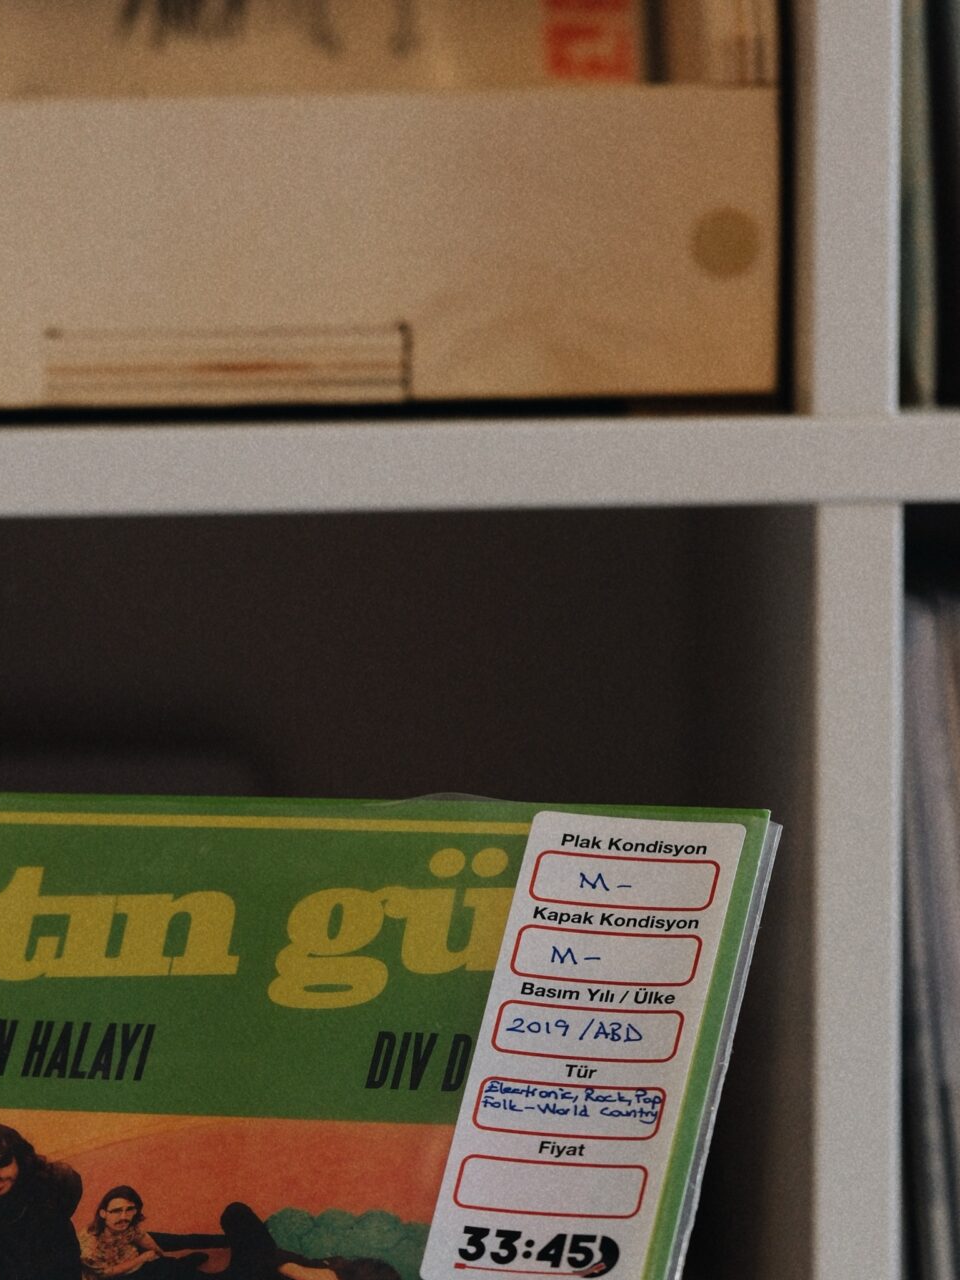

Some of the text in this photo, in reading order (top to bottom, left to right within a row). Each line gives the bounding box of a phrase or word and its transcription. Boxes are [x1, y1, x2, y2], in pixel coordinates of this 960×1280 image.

[560, 833, 708, 856] Plak Kondisyon
[532, 906, 699, 931] Kapak Kondisyon
[520, 981, 676, 1005] Basım Yılı / Ülke
[506, 1017, 570, 1037] 2019
[20, 1022, 156, 1082] HALAYI
[366, 1030, 438, 1091] DIV
[565, 1064, 597, 1079] Tür
[636, 1089, 662, 1107] Pop
[538, 1140, 586, 1158] Fiyat
[458, 1225, 596, 1269] 33:45
